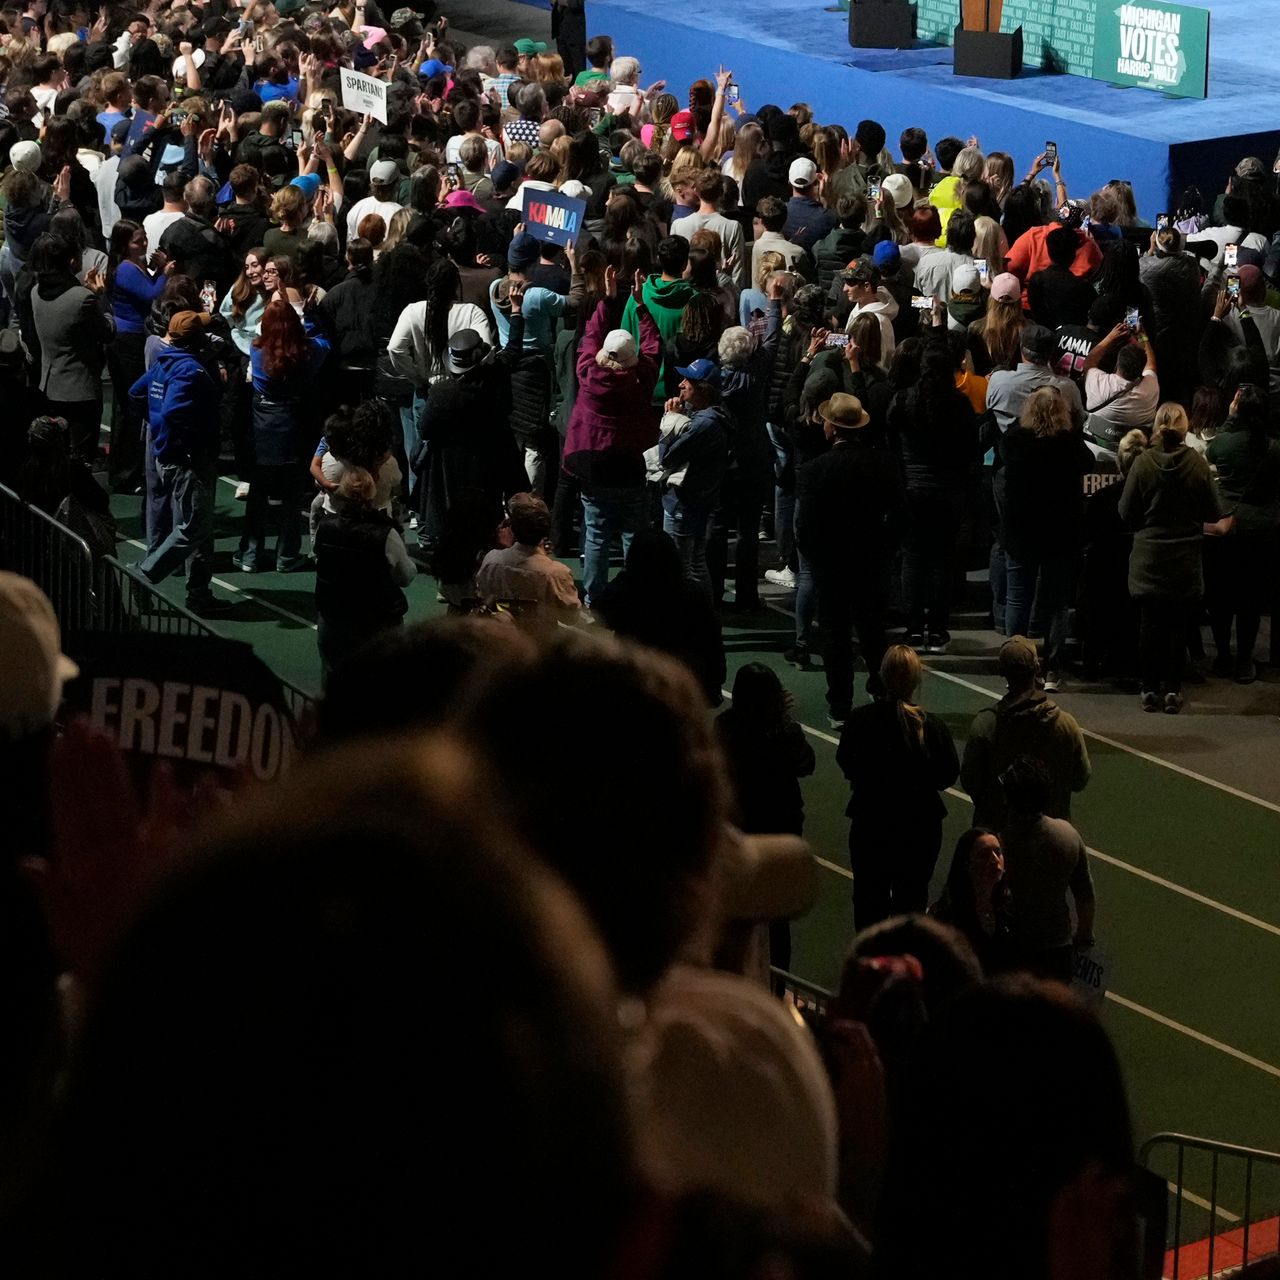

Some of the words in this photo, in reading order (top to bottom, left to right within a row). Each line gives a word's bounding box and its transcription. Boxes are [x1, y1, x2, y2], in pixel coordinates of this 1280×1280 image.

[1120, 5, 1181, 34] MICHIGAN
[1120, 24, 1180, 66] VOTES
[528, 201, 577, 233] KAMALA
[1058, 335, 1092, 356] KAMAL
[92, 676, 291, 782] FREEDO
